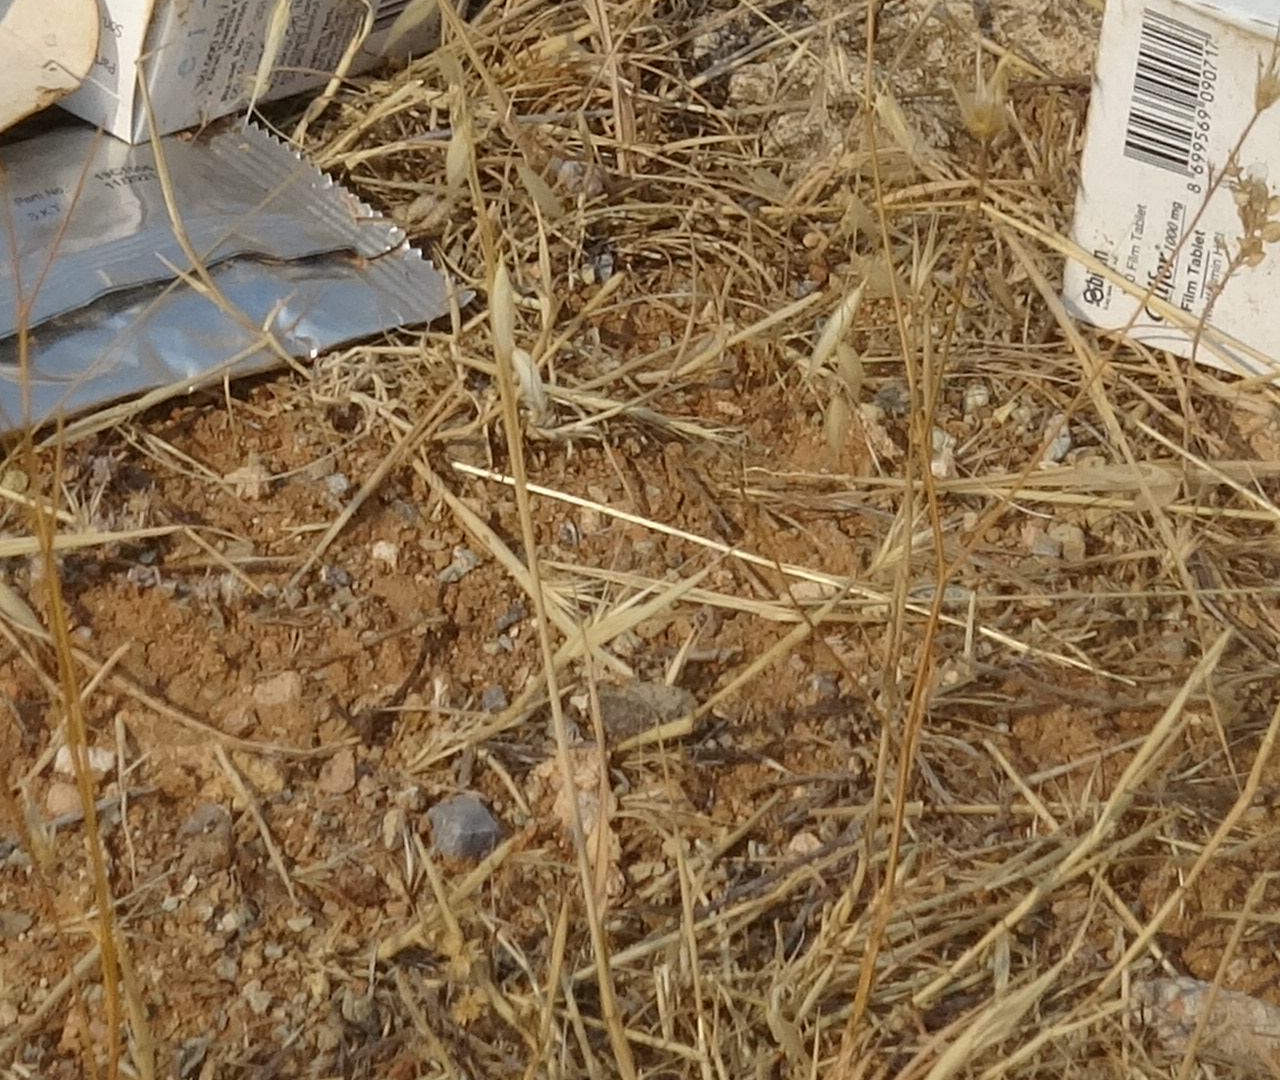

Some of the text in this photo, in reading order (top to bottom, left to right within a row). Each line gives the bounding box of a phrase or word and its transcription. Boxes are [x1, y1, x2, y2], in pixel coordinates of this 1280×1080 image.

[1187, 38, 1219, 194] 8 699569 090717
[1187, 230, 1206, 277] Tablet
